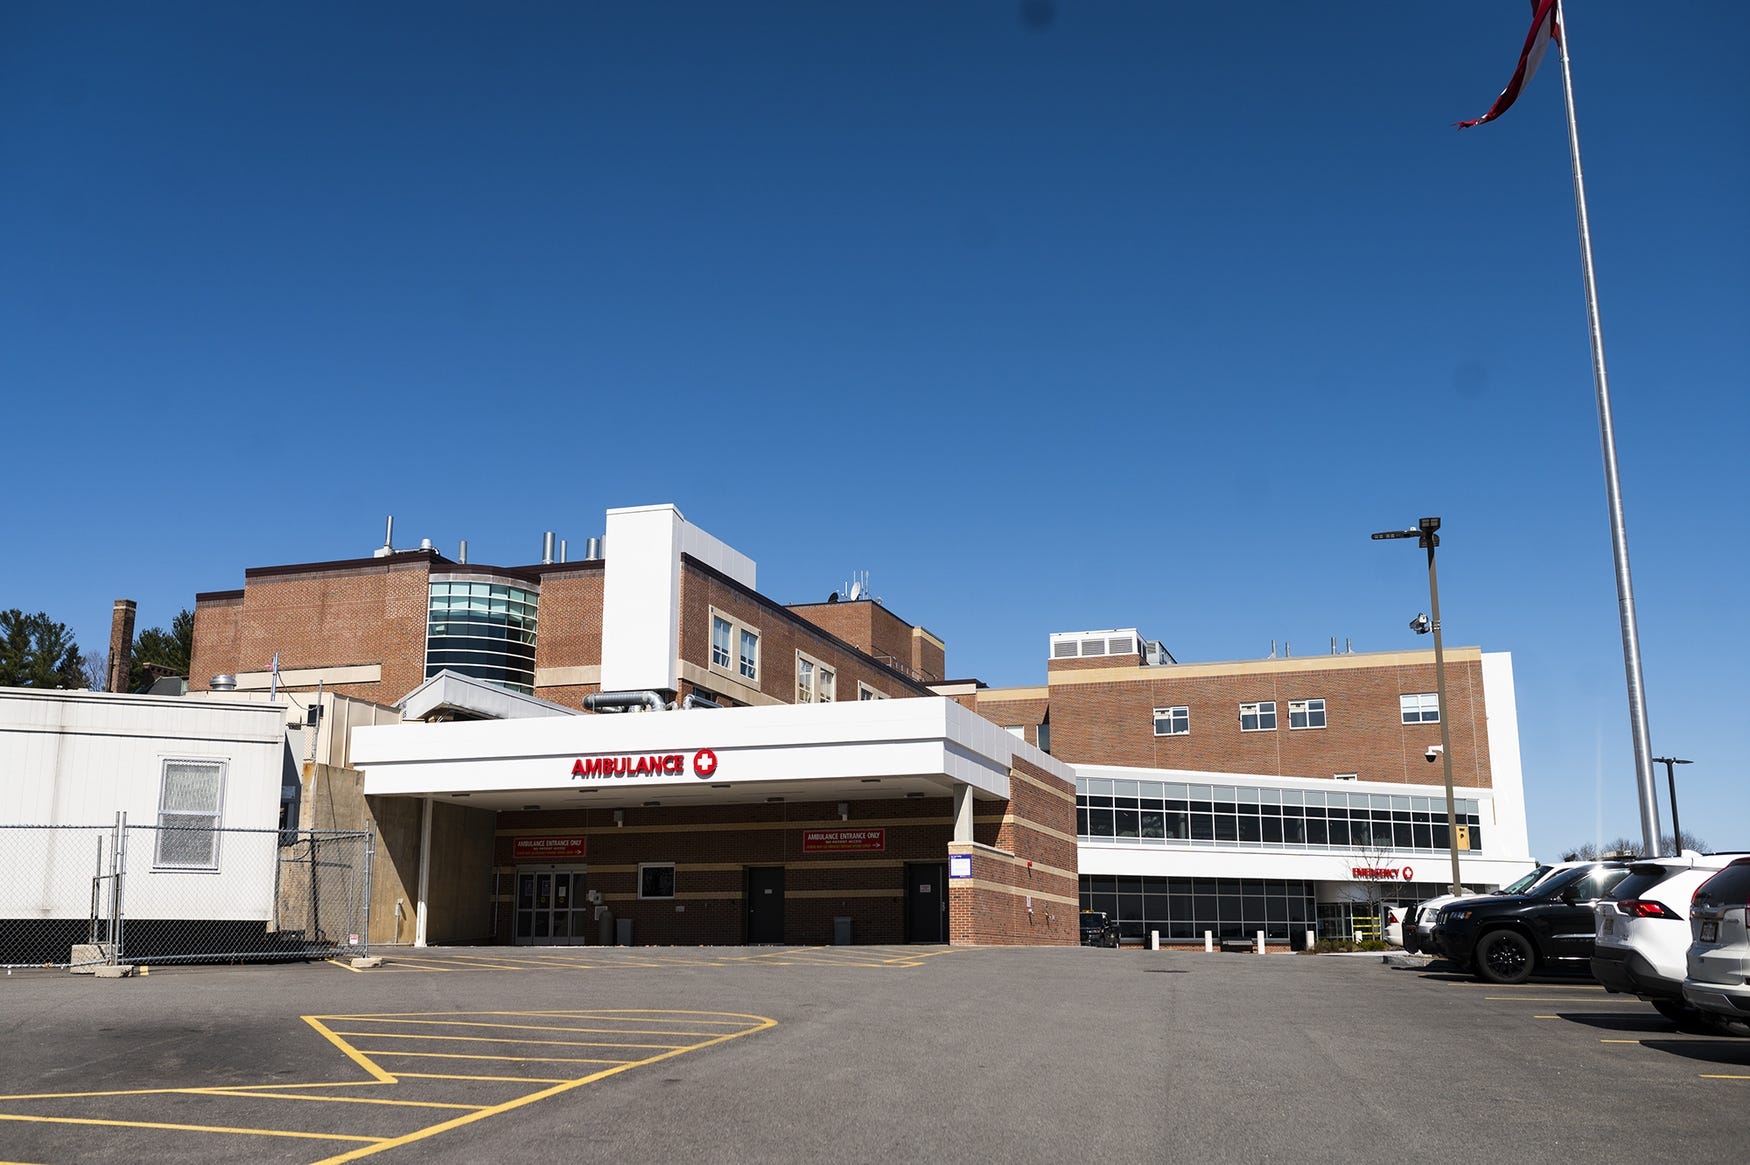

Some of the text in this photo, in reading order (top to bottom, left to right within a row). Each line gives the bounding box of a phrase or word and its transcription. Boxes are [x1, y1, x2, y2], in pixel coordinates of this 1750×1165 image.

[571, 755, 685, 777] AMBULANCE
[840, 832, 866, 840] ENTRANCE
[1352, 868, 1399, 879] EMERGENCY
